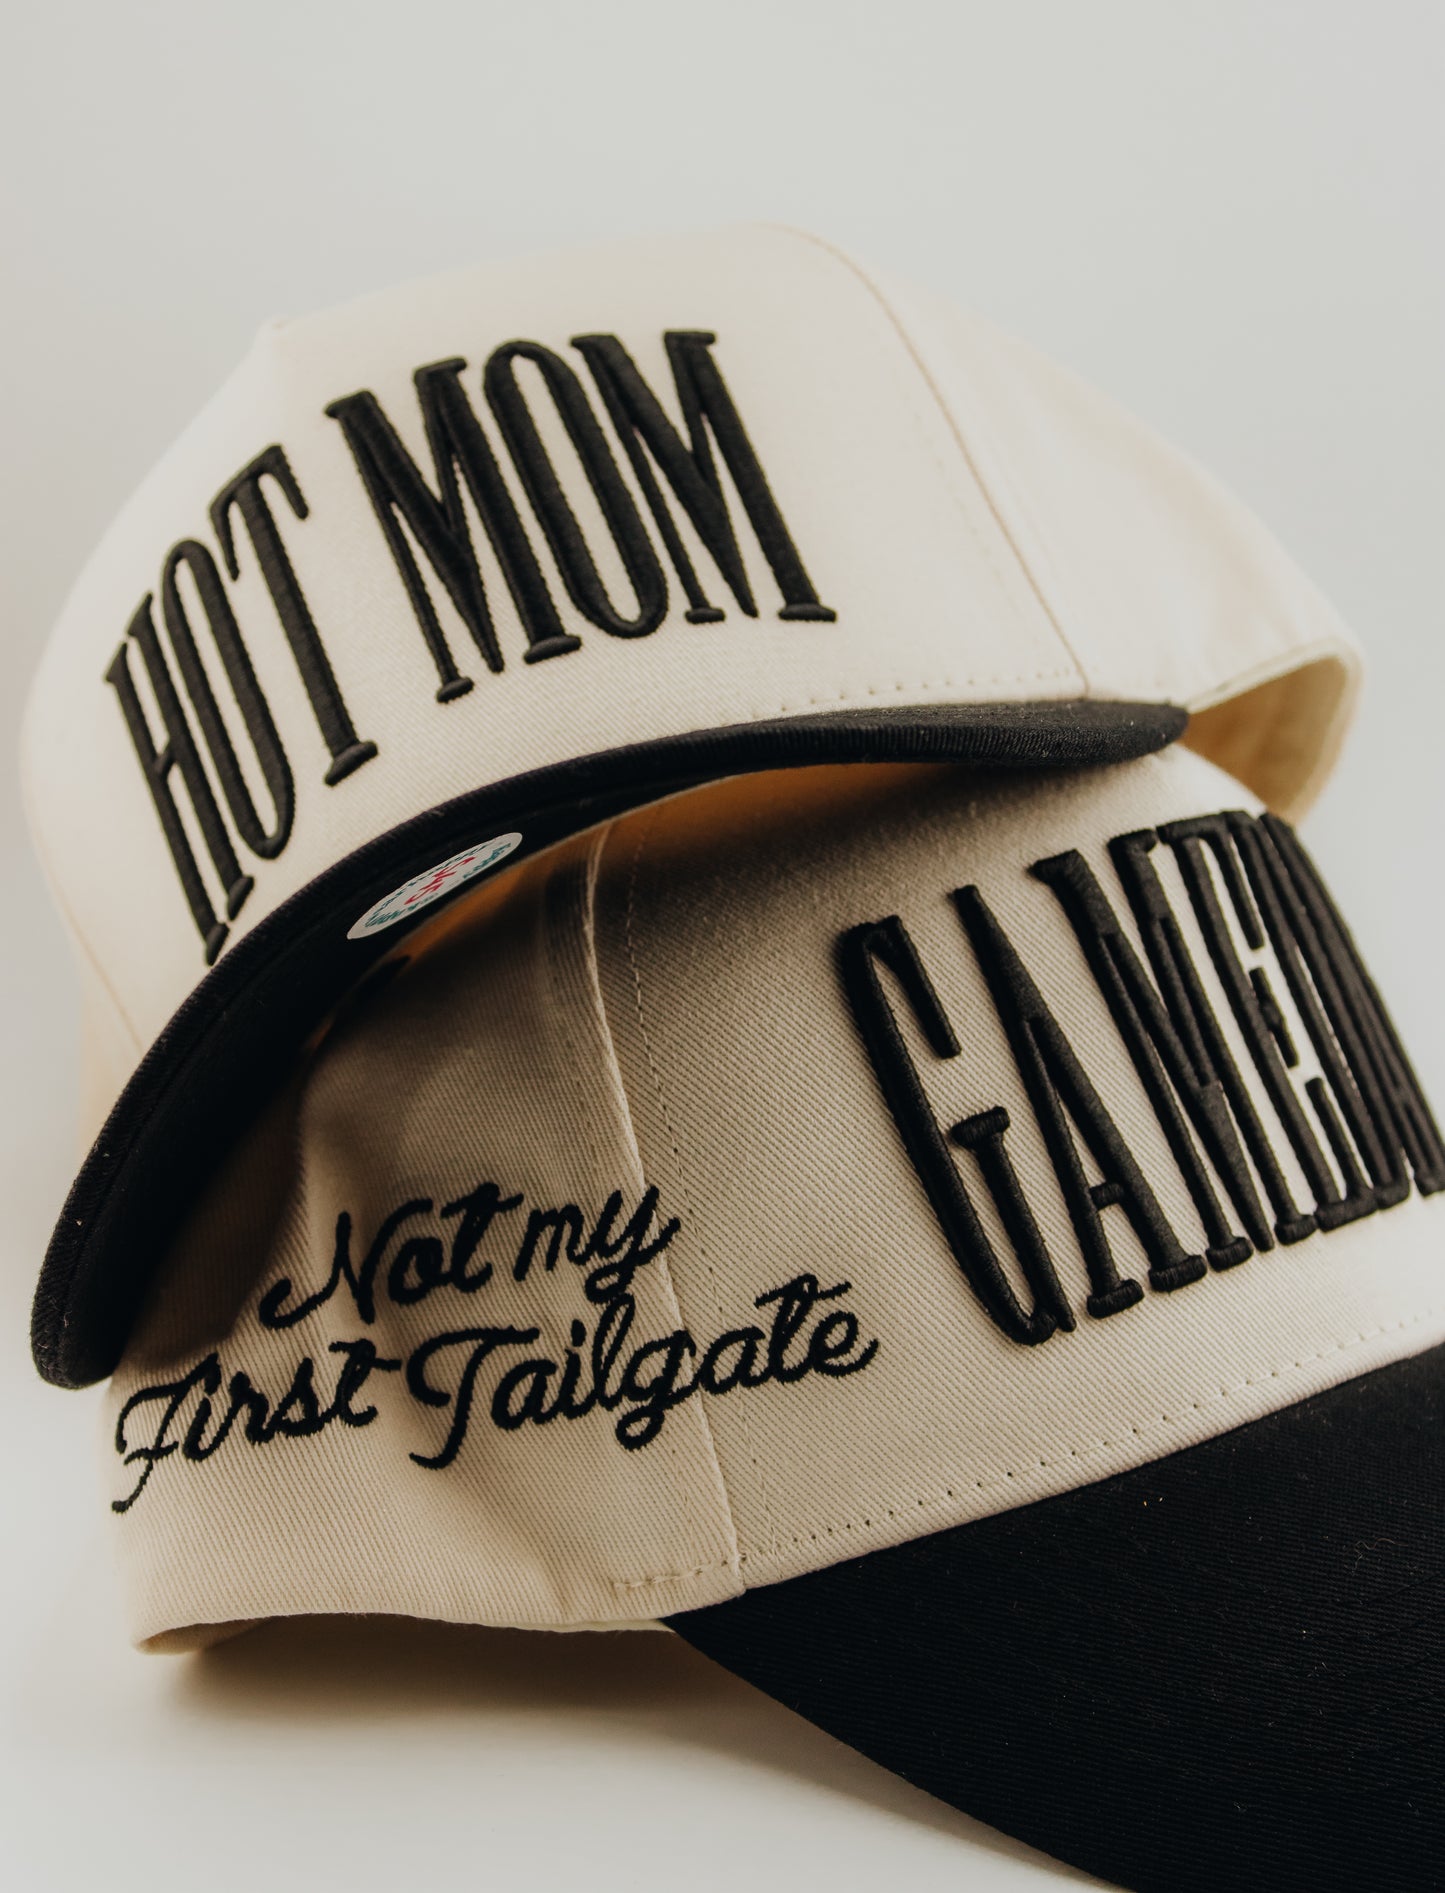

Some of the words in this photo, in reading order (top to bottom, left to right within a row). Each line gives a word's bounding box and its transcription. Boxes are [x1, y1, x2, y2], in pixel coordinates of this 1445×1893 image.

[104, 443, 379, 966] HOT
[323, 329, 838, 704] MOM
[258, 1182, 524, 1329] Not
[512, 1184, 682, 1304] my
[111, 1338, 403, 1513] First
[406, 1272, 880, 1470] Tailgate
